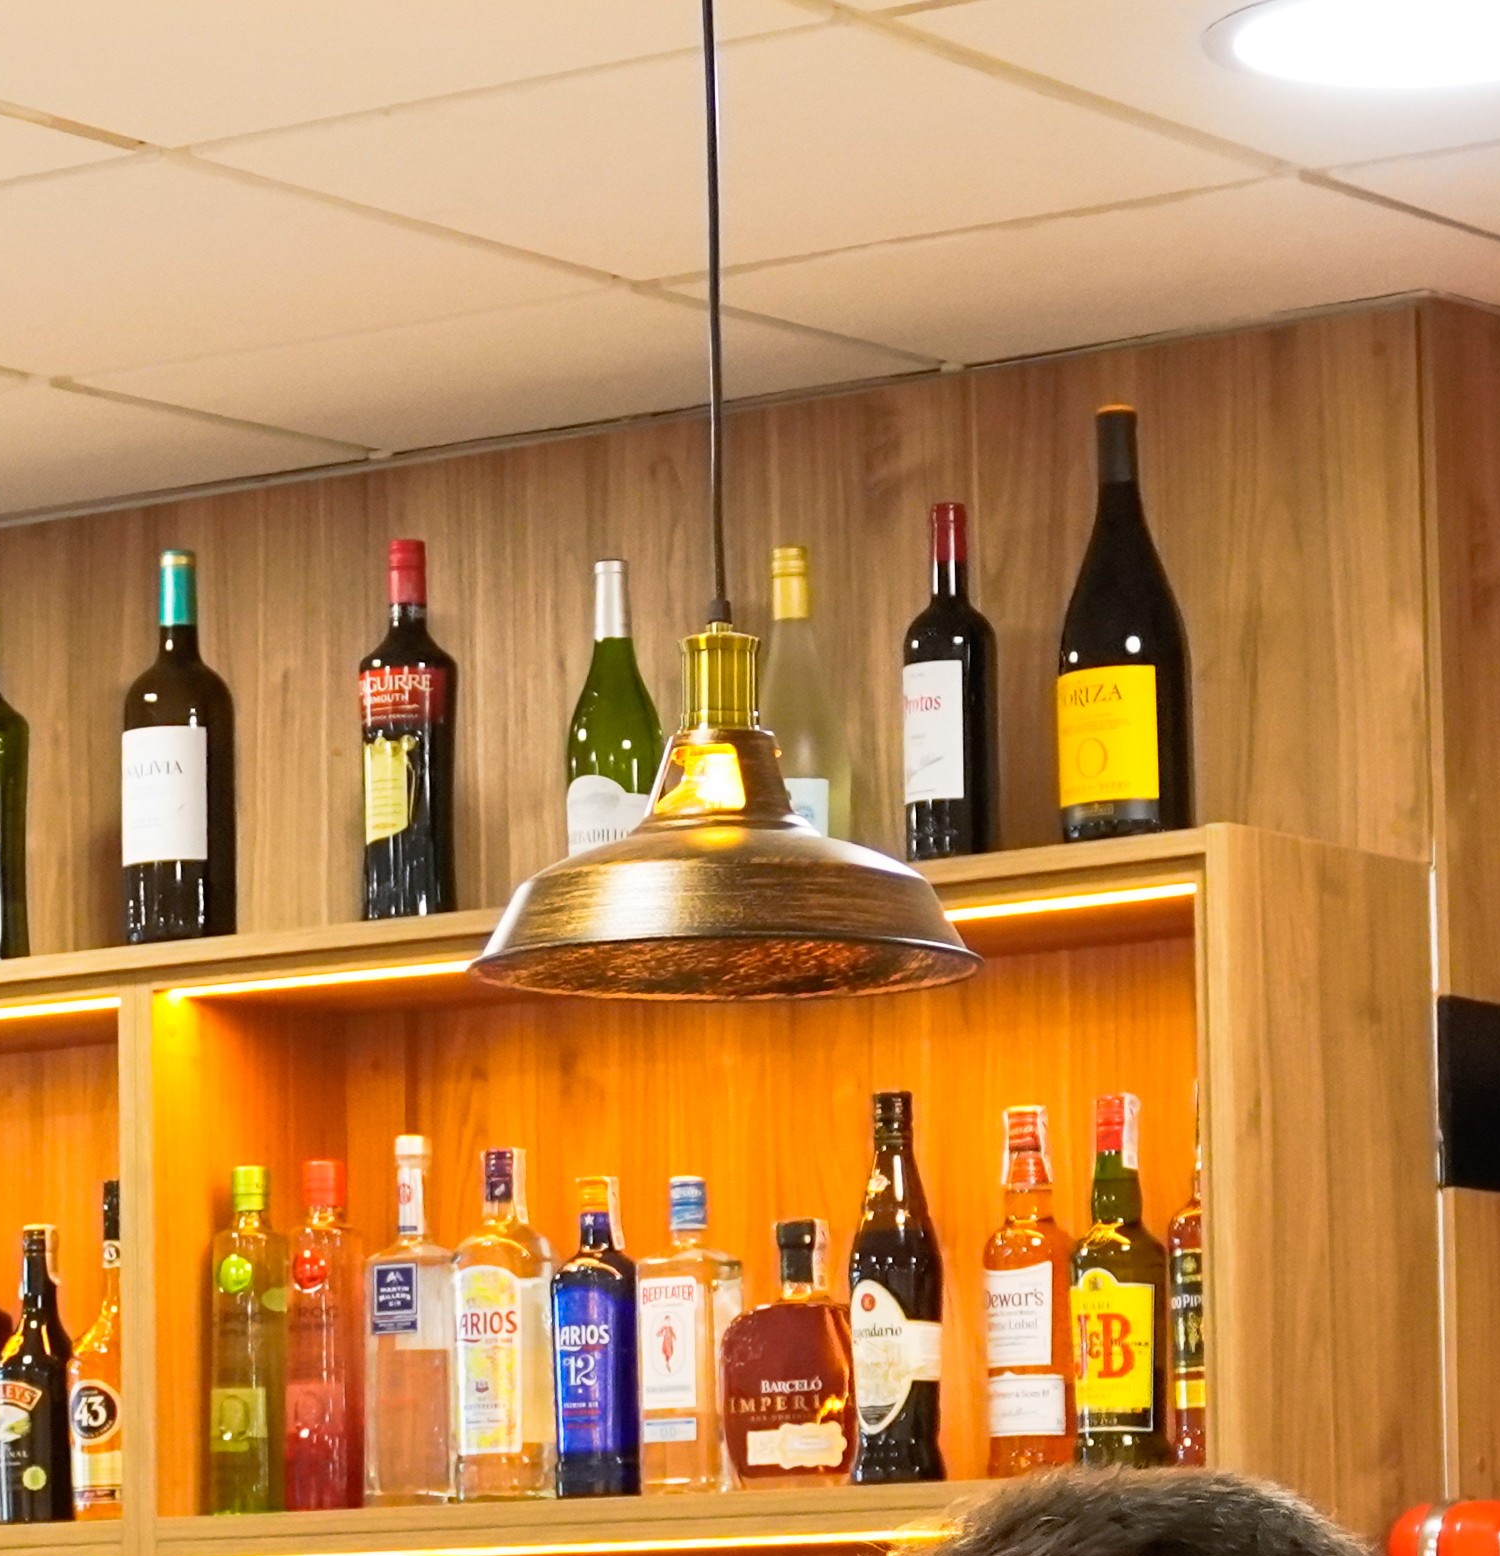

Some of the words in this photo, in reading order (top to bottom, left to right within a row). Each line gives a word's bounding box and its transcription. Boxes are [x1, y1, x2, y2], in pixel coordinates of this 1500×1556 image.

[360, 674, 433, 692] GUIRRE
[642, 1284, 694, 1305] BEEFEATER
[1076, 1313, 1135, 1380] J&B
[761, 1375, 823, 1394] BARCELÓ
[75, 1395, 107, 1428] 43
[730, 1394, 850, 1415] IMPERI
